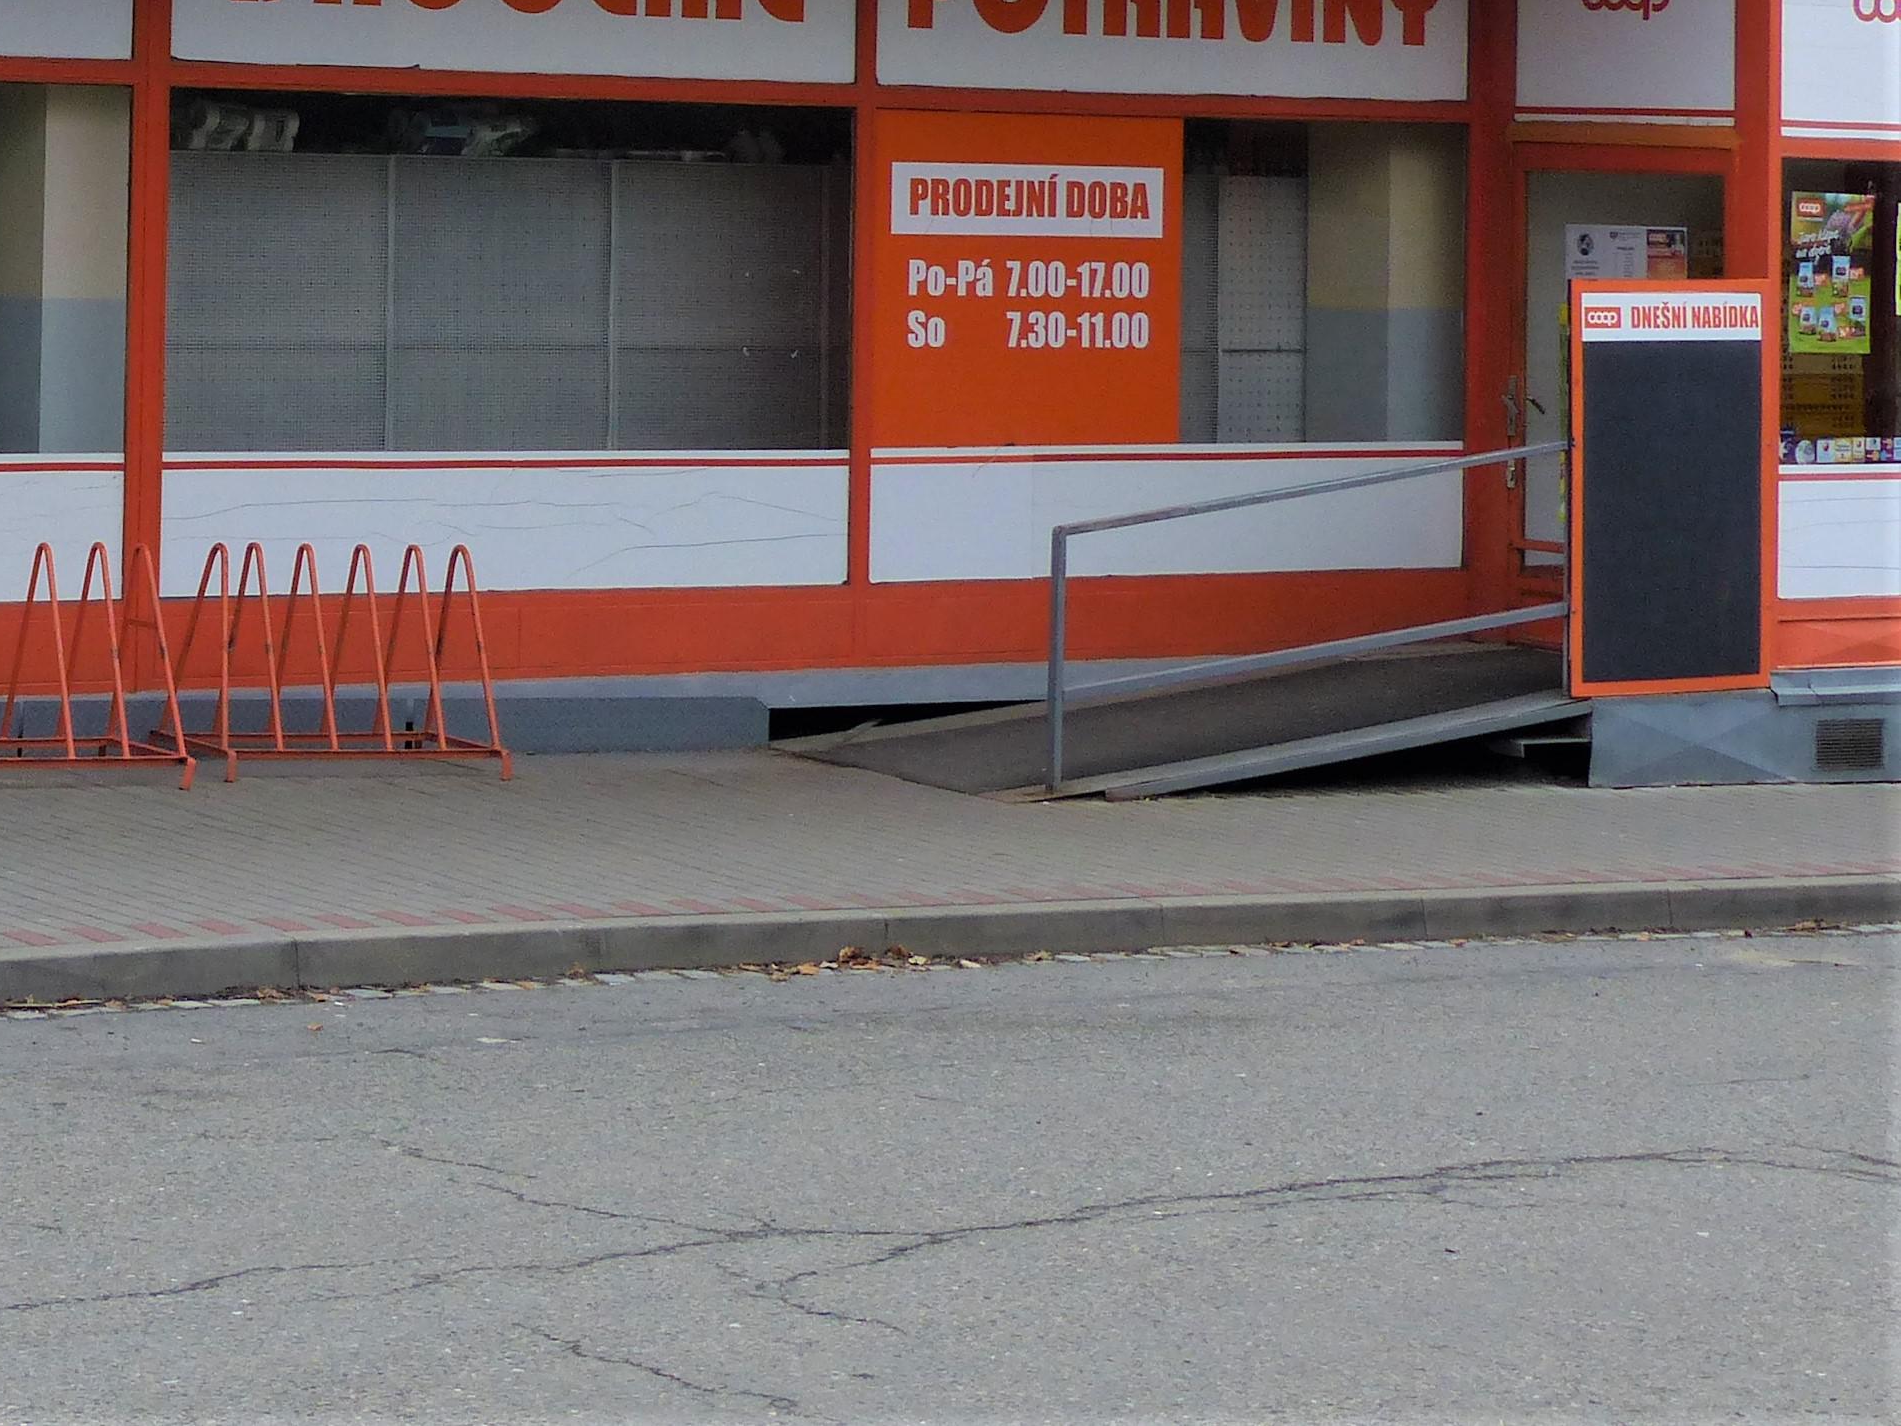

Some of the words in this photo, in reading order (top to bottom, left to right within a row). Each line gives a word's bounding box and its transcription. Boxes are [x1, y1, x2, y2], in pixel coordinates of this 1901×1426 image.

[908, 173, 1058, 219] PRODEJNÍ
[1065, 180, 1150, 220] DOBA
[907, 258, 994, 297] Po-Pá
[1005, 260, 1150, 298] 7.00-17.00
[906, 309, 946, 348] So
[1005, 311, 1150, 349] 7.30-11.00
[1586, 311, 1618, 326] coop
[1630, 301, 1688, 329] DNEŠNÍ
[1691, 301, 1760, 329] NABÍDKA
